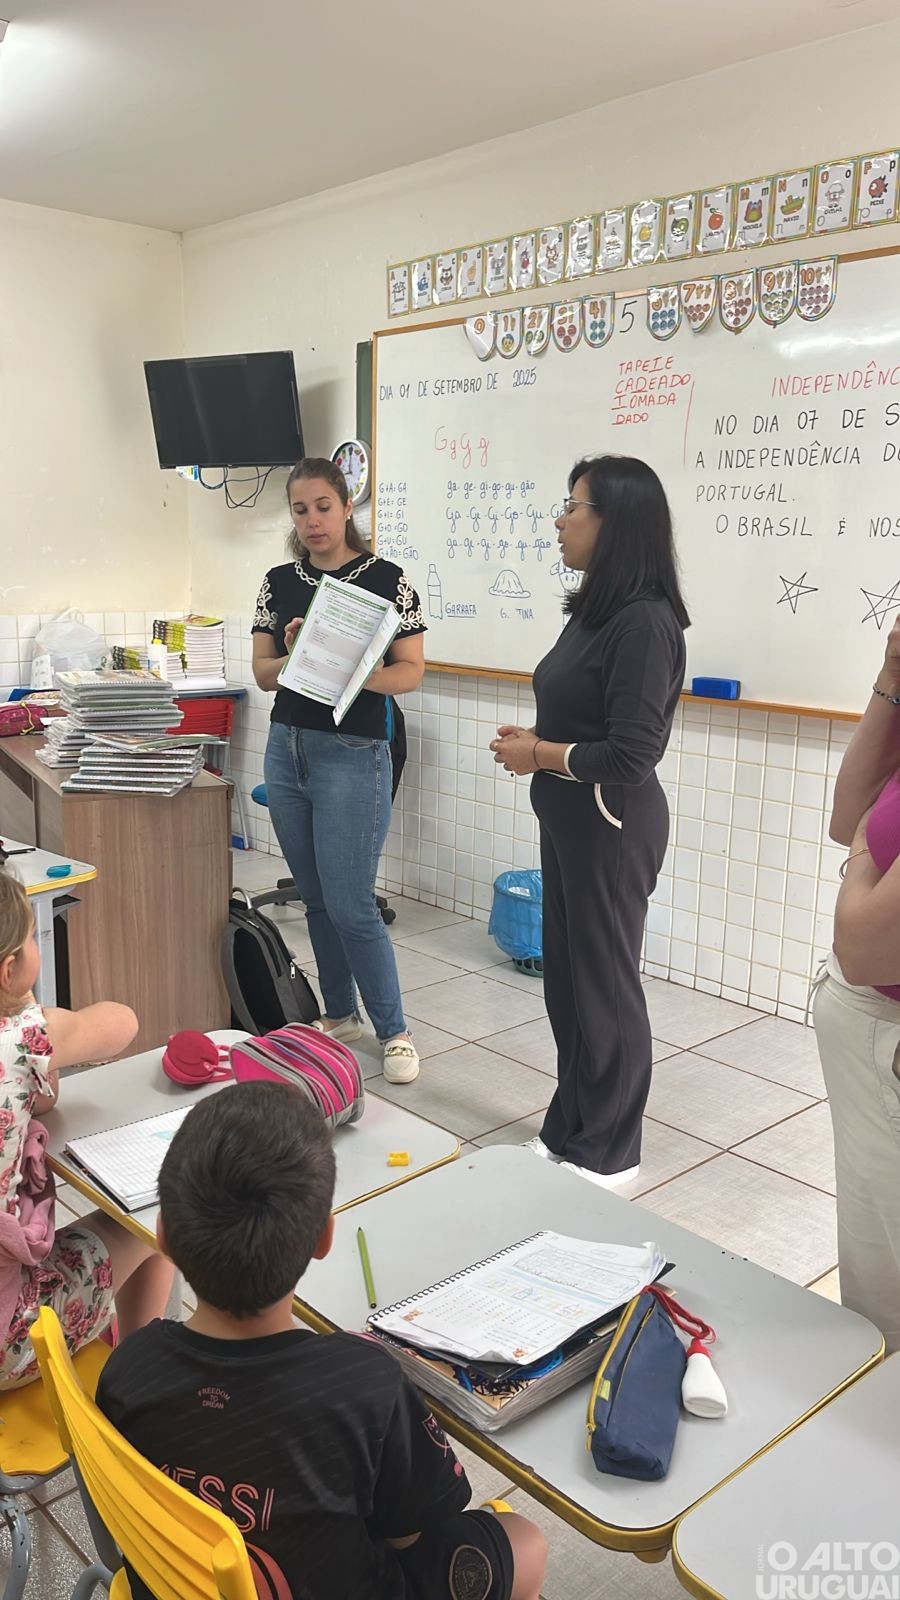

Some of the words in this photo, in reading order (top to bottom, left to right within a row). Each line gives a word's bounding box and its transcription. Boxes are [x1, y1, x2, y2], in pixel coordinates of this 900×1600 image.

[889, 160, 896, 172] p
[778, 179, 787, 192] N
[802, 178, 808, 187] n
[820, 171, 829, 183] O
[845, 170, 852, 178] o
[762, 187, 769, 196] m
[704, 196, 711, 208] L
[477, 250, 481, 258] d
[764, 271, 776, 292] 9
[800, 268, 815, 286] 10
[682, 284, 696, 302] 7
[589, 301, 600, 319] 4
[619, 300, 637, 333] 5
[503, 315, 509, 332] 1
[528, 311, 538, 329] 2
[380, 386, 393, 400] DIA
[400, 384, 410, 398] 01
[418, 380, 429, 397] DE
[433, 377, 482, 396] SETEMBRO
[487, 373, 499, 390] DE
[513, 367, 537, 387] 2025
[616, 374, 691, 394] CADEADO
[613, 412, 649, 424] DADO
[714, 414, 737, 435] NO
[753, 415, 780, 434] DIA
[797, 409, 819, 430] 07
[842, 407, 867, 429] DE
[695, 451, 705, 469] A
[718, 440, 860, 470] INDEPENDÊNCIA
[883, 443, 900, 462] D
[716, 514, 729, 534] O
[737, 516, 813, 537] BRASIL
[445, 602, 477, 616] GARRAFA
[160, 1464, 274, 1532] SSI
